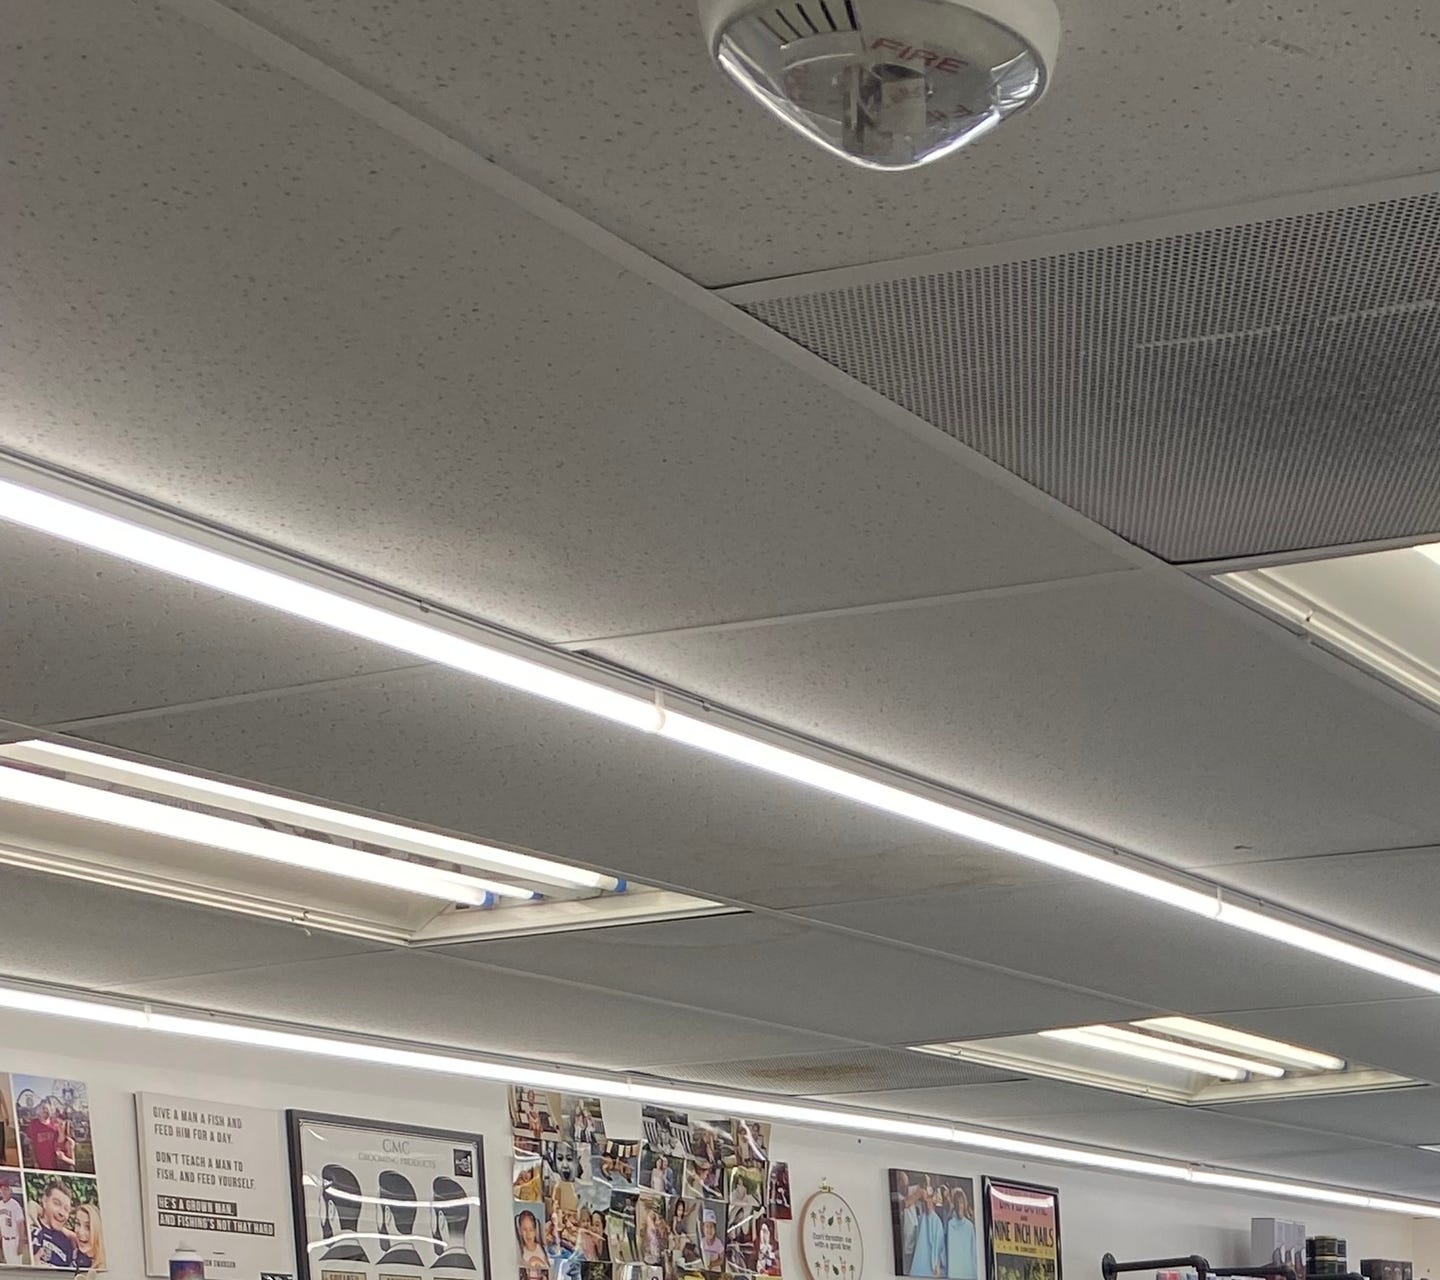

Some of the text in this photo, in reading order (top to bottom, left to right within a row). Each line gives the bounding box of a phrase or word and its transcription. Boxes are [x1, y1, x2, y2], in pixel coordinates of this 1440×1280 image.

[871, 37, 969, 75] FIRE
[153, 1106, 242, 1129] GIVE A MAN A FISH AND
[154, 1124, 173, 1137] FEED
[175, 1126, 191, 1139] HIM
[193, 1128, 208, 1141] FOR
[209, 1131, 215, 1142] A
[382, 1138, 411, 1154] CMC
[181, 1153, 206, 1168] TEACH
[208, 1158, 213, 1168] A
[215, 1159, 232, 1171] MAN
[234, 1161, 243, 1172] TO
[180, 1170, 195, 1183] AND
[197, 1172, 216, 1185] FEED
[178, 1198, 185, 1210] A
[186, 1199, 213, 1213] GROWN
[160, 1213, 176, 1226] AND
[216, 1219, 232, 1231] NOT
[234, 1221, 252, 1234] THAT
[994, 1219, 1054, 1247] NINE INCH NAILS
